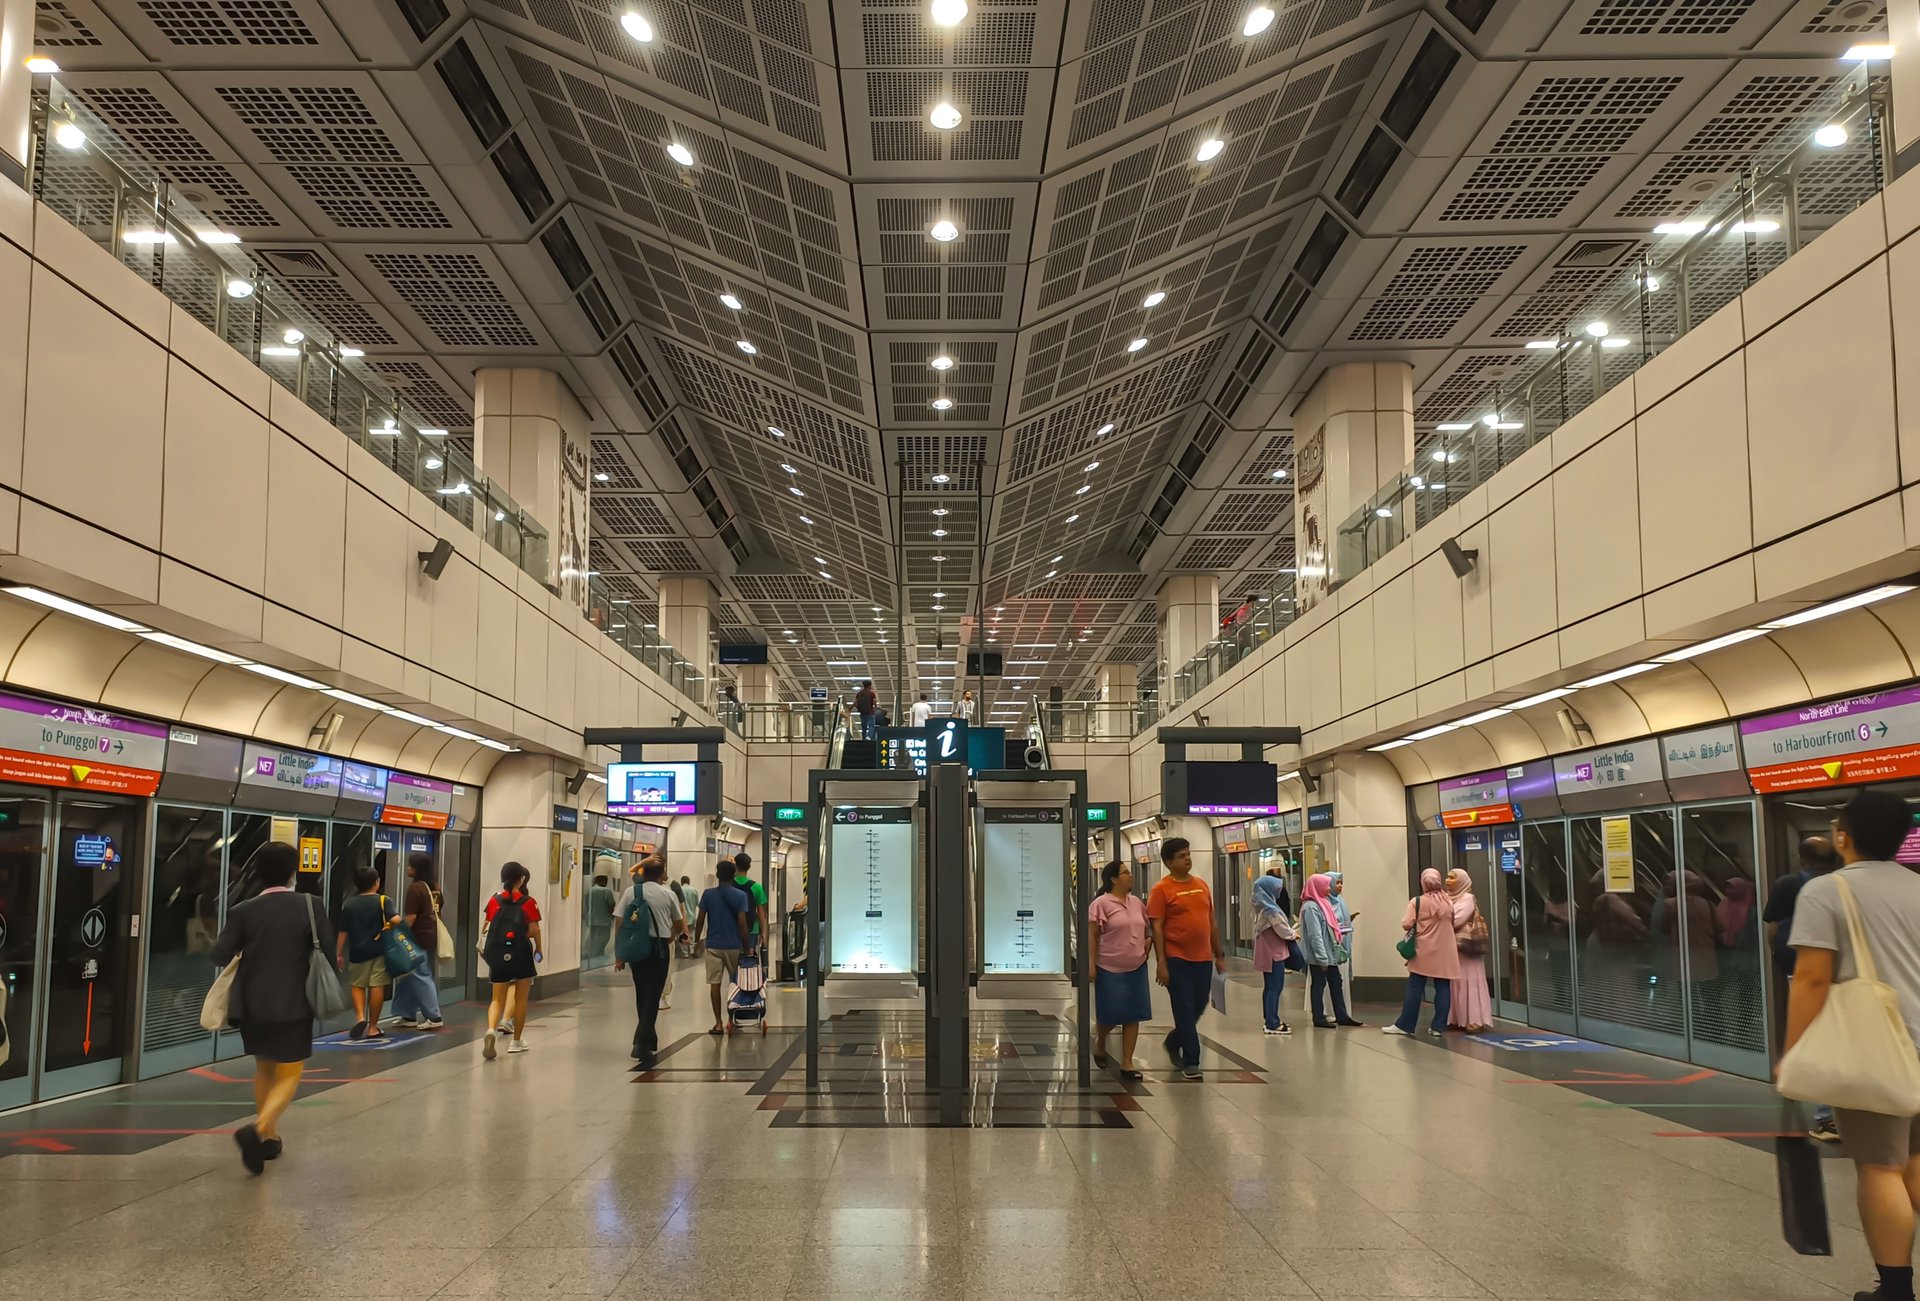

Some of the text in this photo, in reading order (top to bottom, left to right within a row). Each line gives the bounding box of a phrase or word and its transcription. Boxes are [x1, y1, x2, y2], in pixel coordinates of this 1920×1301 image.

[1800, 703, 1849, 721] North East Line
[42, 727, 109, 752] to Punggol 7
[1773, 724, 1869, 754] to HarbourFront 6
[259, 760, 272, 773] NE7
[279, 752, 315, 771] Little India
[1594, 750, 1634, 769] Little India
[1577, 767, 1589, 778] NE7
[779, 810, 793, 819] EXIT
[1088, 811, 1103, 819] EXIT
